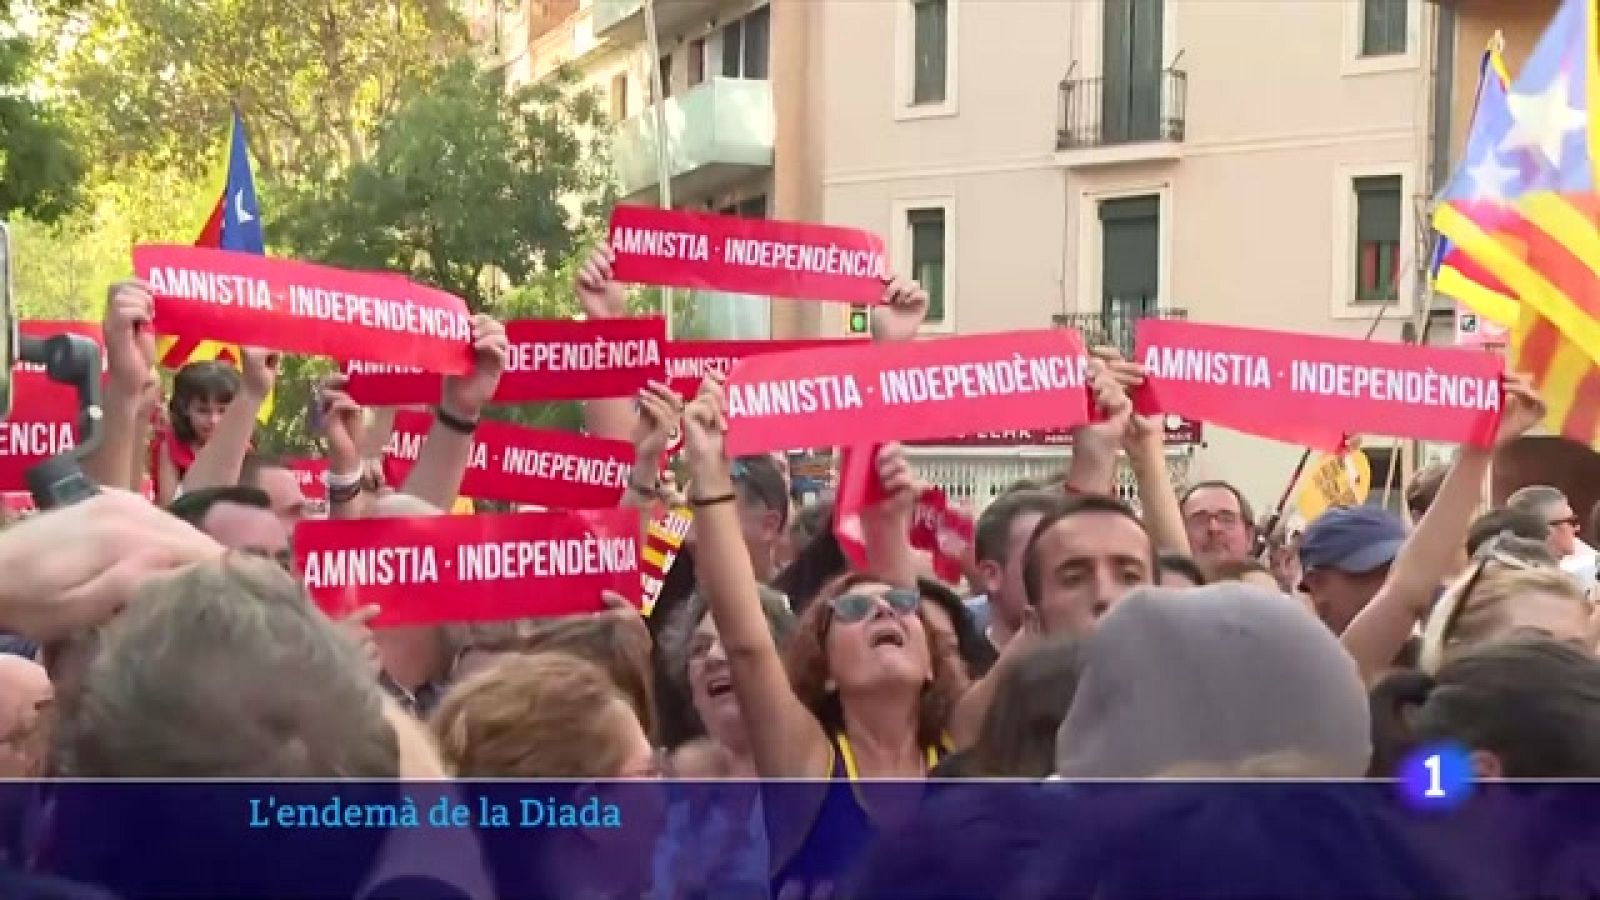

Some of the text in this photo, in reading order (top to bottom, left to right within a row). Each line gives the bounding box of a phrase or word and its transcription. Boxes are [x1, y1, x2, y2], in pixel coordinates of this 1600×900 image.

[612, 227, 886, 278] AMNISTIA INDEPENDÈNCIA
[149, 266, 471, 342] AMNISTIA INDEPENDÈNCIA
[504, 335, 661, 371] DEPENDÈNCIA
[1144, 345, 1500, 411] AMNISTIA INDEPENDÈNCIA
[729, 374, 862, 418] AMNISTIA
[502, 446, 631, 488] INDEPENDÈN
[304, 532, 638, 589] AMNISTIA INDEPENDÈNCIA
